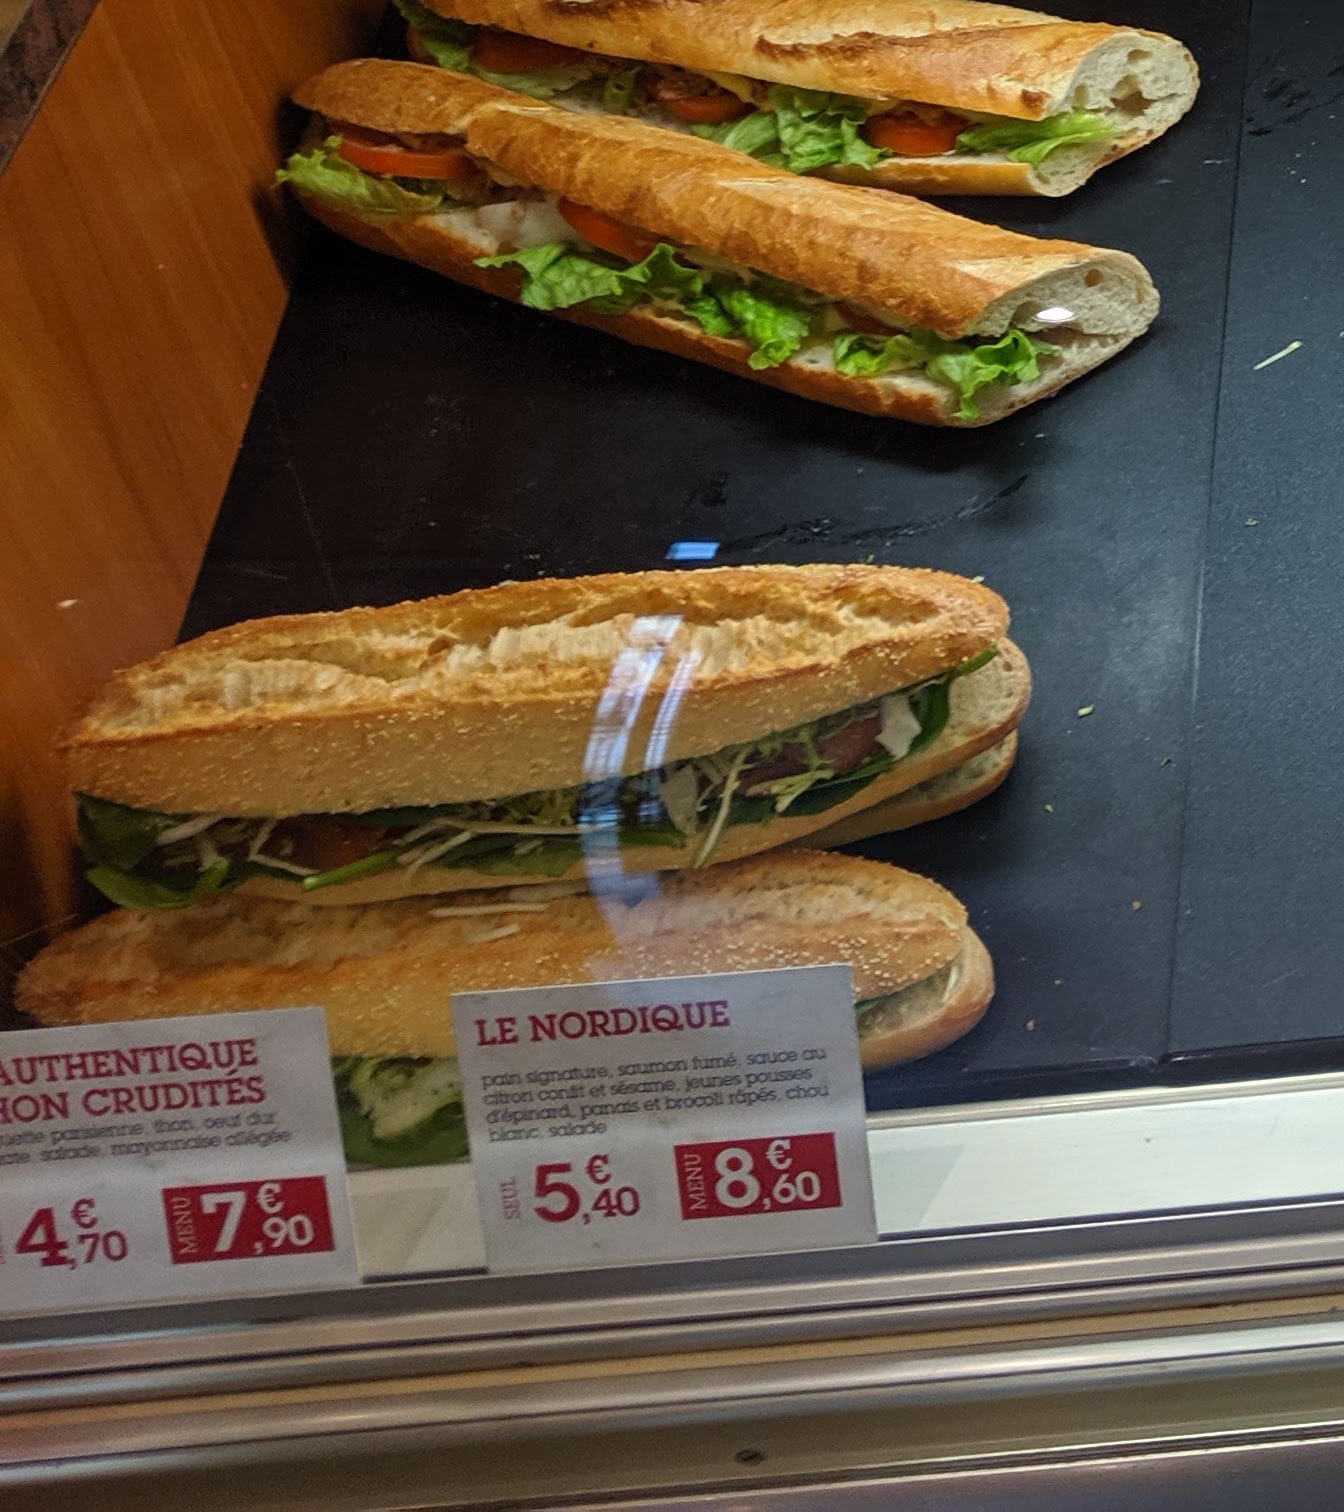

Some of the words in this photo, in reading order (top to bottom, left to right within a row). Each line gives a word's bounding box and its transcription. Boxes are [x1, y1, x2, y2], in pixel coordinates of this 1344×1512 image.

[475, 1016, 519, 1047] LE
[528, 999, 731, 1043] NORDIQUE
[82, 1068, 266, 1117] CRUDITÉS
[482, 1071, 523, 1091] pain
[617, 1056, 689, 1078] saumon
[746, 1049, 799, 1067] sauce
[802, 1047, 827, 1061] au
[484, 1088, 534, 1108] citron
[536, 1082, 587, 1104] confit
[589, 1081, 608, 1099] et
[684, 1070, 743, 1092] jeunes
[746, 1067, 813, 1089] pousses
[580, 1099, 641, 1121] panais
[643, 1095, 662, 1112] et
[664, 1091, 725, 1112] brocoli
[785, 1081, 830, 1101] chou
[683, 1152, 707, 1211] MENU
[171, 1196, 199, 1255] MENU
